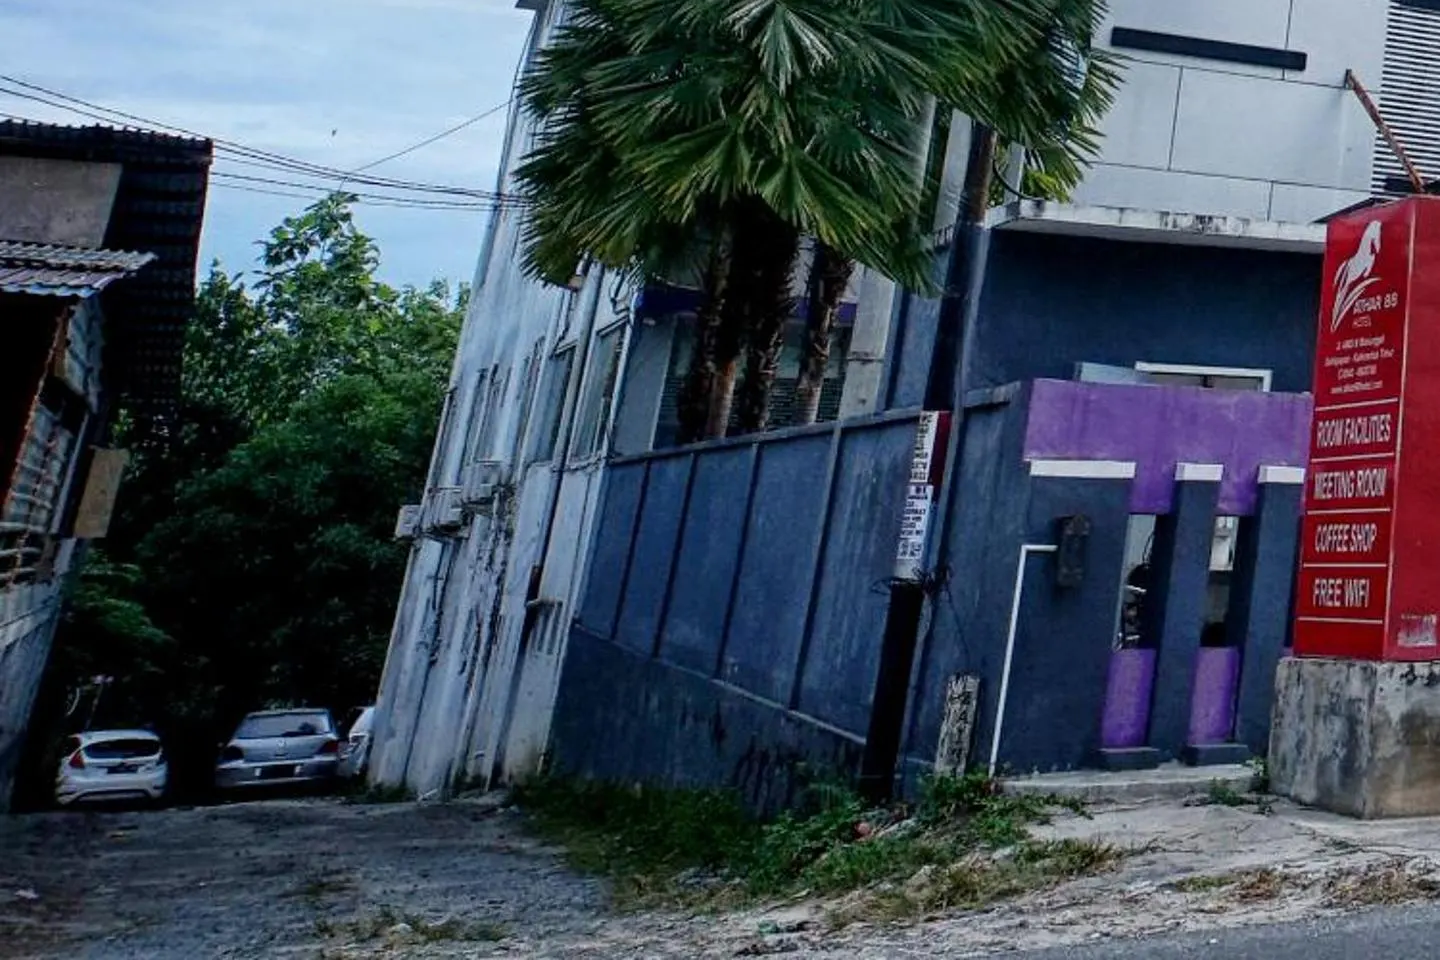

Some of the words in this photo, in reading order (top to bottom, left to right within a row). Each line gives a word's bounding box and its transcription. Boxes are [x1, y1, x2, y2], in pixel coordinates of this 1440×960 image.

[1384, 292, 1398, 309] 88
[1317, 418, 1343, 448] ROOM
[1344, 414, 1391, 445] FACILITIES
[1314, 470, 1354, 500] MEETING
[1356, 468, 1387, 498] ROOM
[1315, 524, 1349, 552] COFFEE
[1350, 523, 1377, 552] SHOP
[1312, 578, 1341, 608] FREE
[1344, 578, 1370, 608] WIFI
